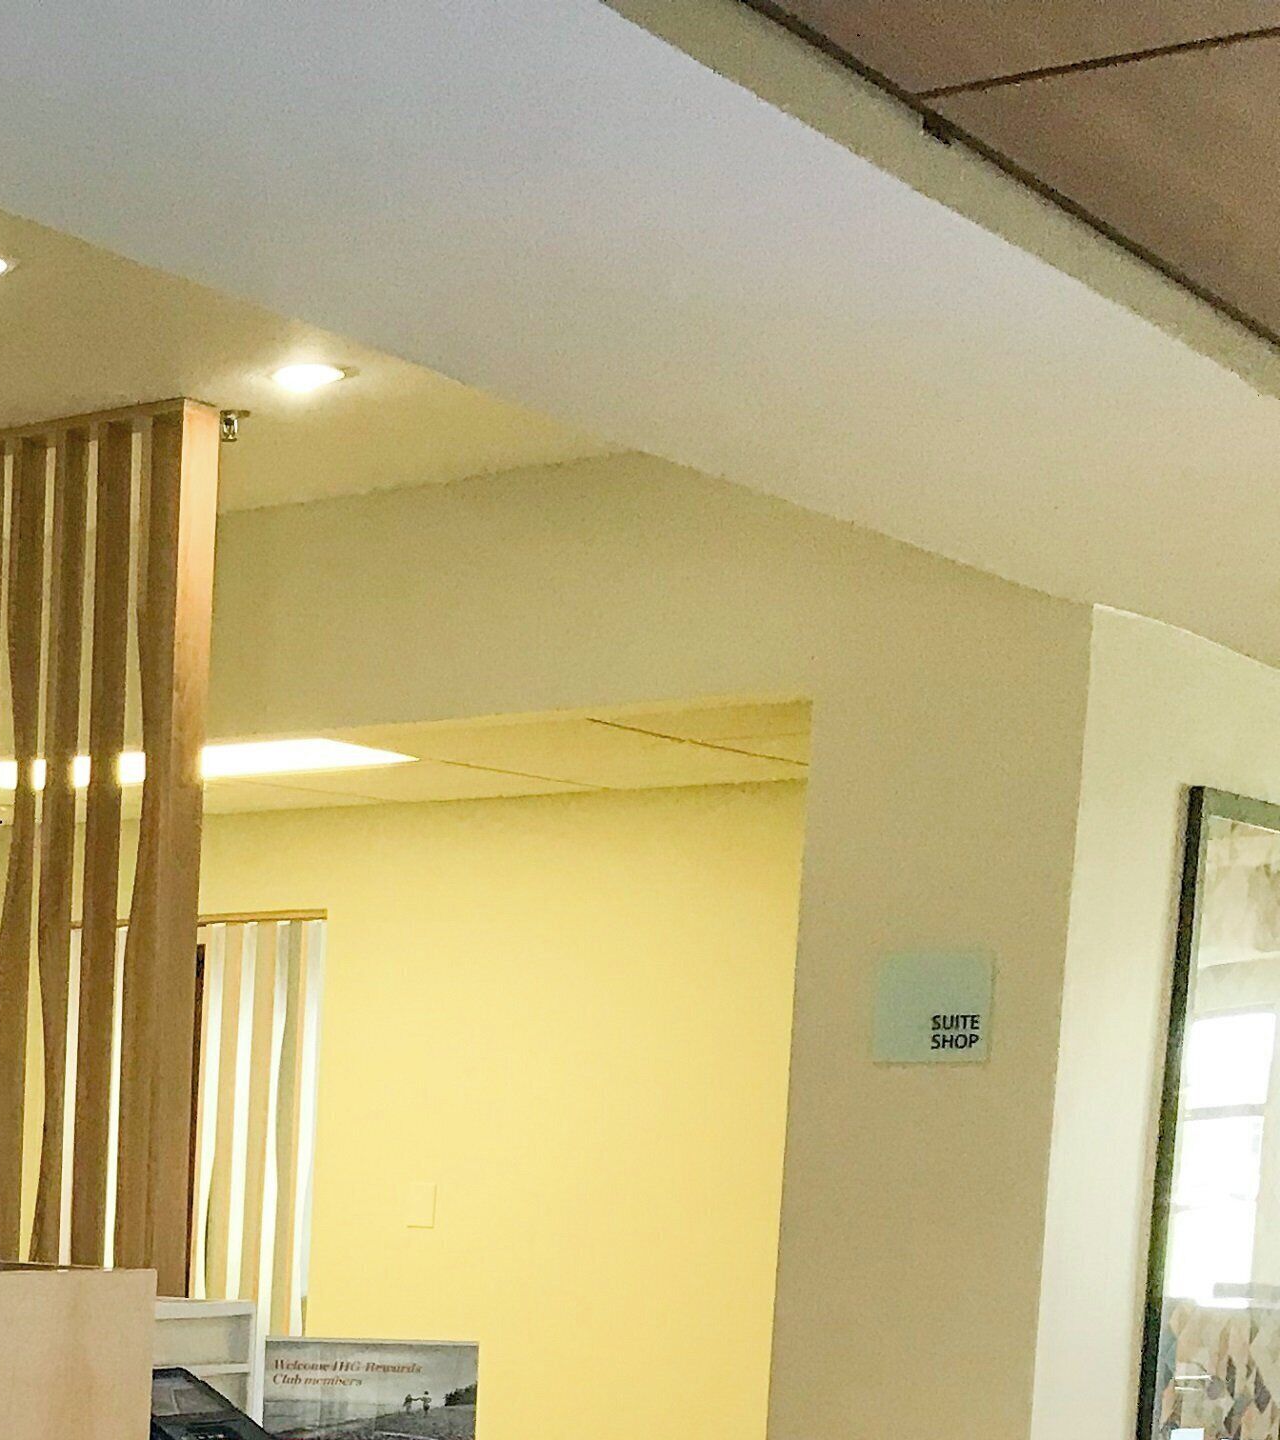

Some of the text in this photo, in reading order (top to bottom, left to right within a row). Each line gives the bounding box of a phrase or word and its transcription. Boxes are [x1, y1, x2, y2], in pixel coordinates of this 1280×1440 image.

[931, 1014, 980, 1030] SUITE
[930, 1034, 980, 1049] SHOP
[273, 1359, 329, 1372] Welcome
[365, 1362, 423, 1374] Rewards
[272, 1373, 362, 1386] Club members
